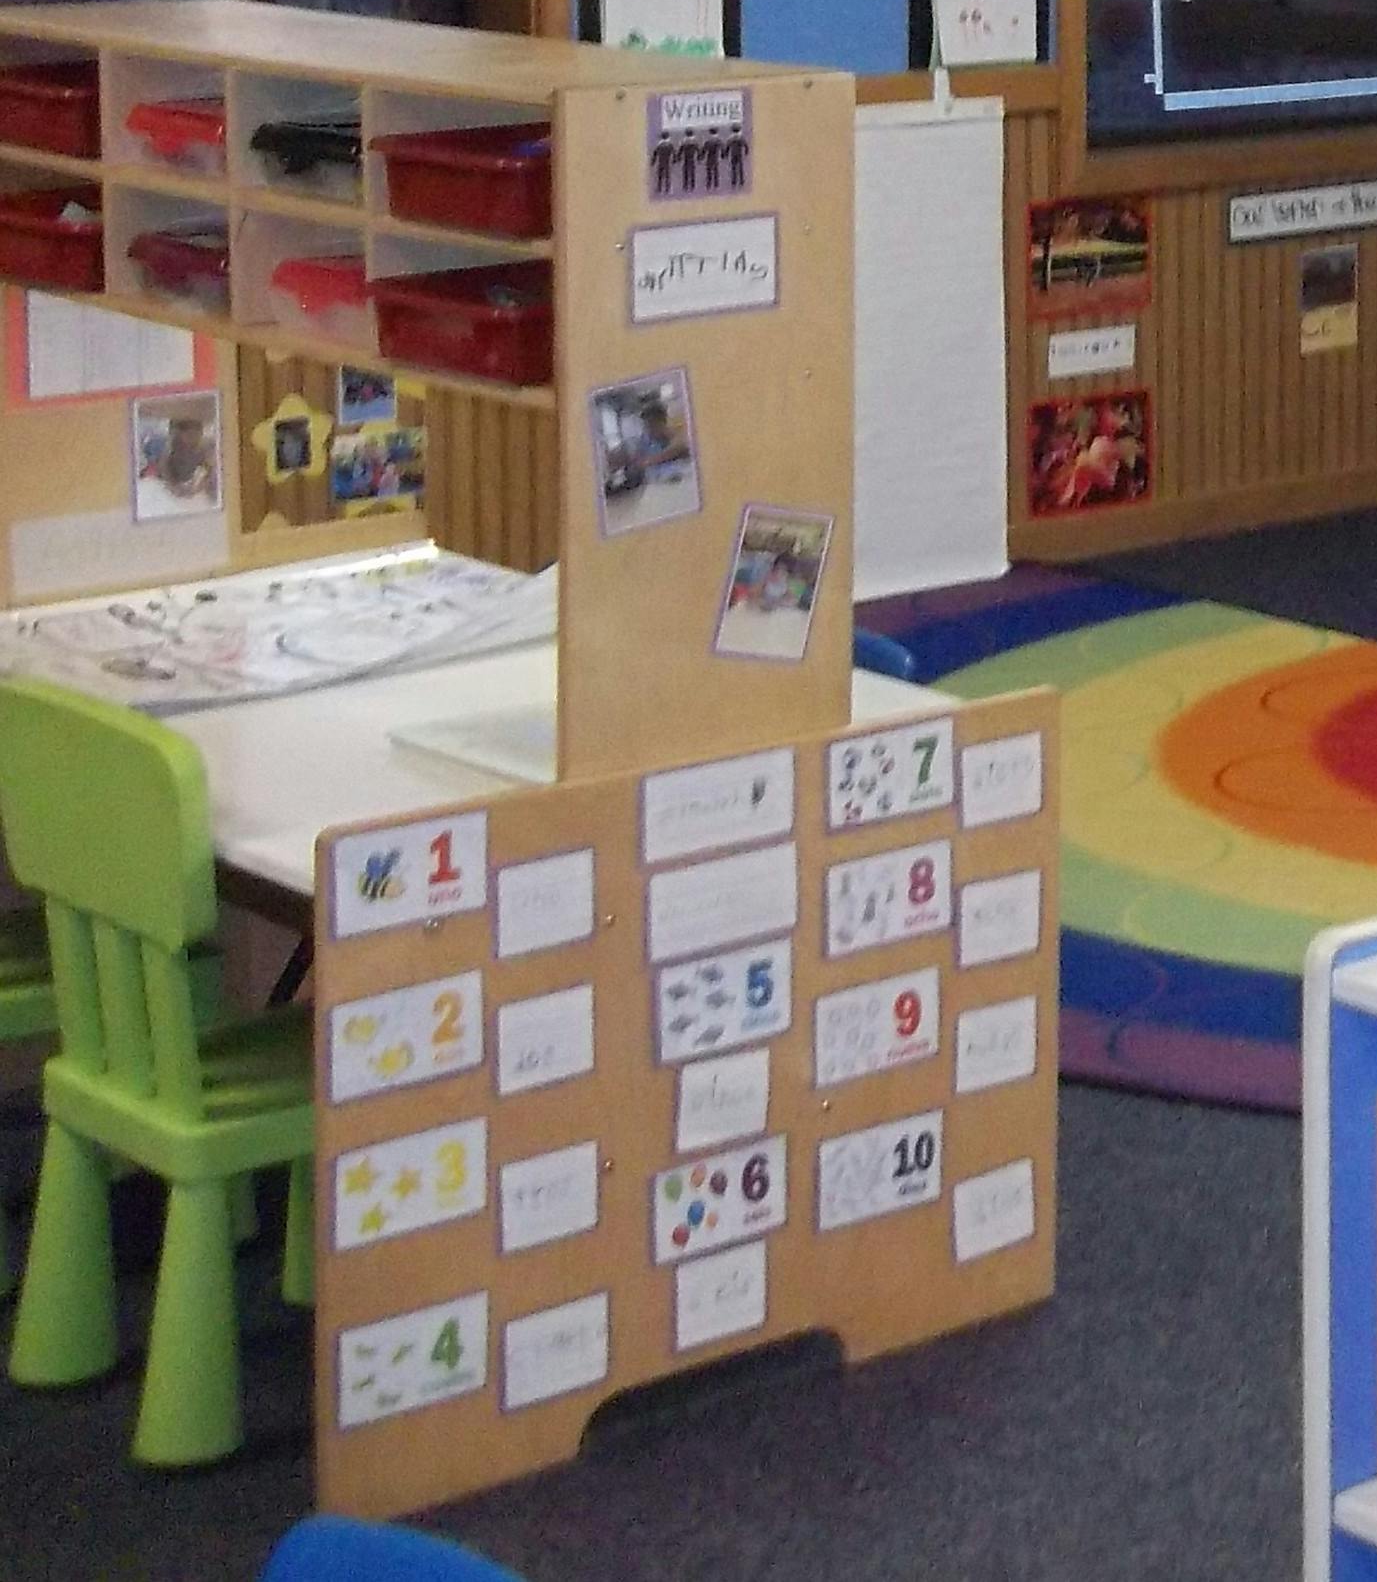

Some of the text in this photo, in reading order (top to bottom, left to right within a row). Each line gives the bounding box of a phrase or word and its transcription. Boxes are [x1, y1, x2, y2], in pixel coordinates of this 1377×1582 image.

[665, 95, 741, 120] Writing
[912, 735, 939, 788] 7
[427, 829, 463, 885] 1
[907, 855, 936, 905] 8
[746, 957, 775, 1009] 5
[430, 988, 466, 1046] 2
[893, 988, 922, 1037] 9
[434, 1138, 469, 1197] 3
[741, 1152, 771, 1203] 6
[892, 1130, 936, 1180] 10
[430, 1317, 464, 1370] 4
